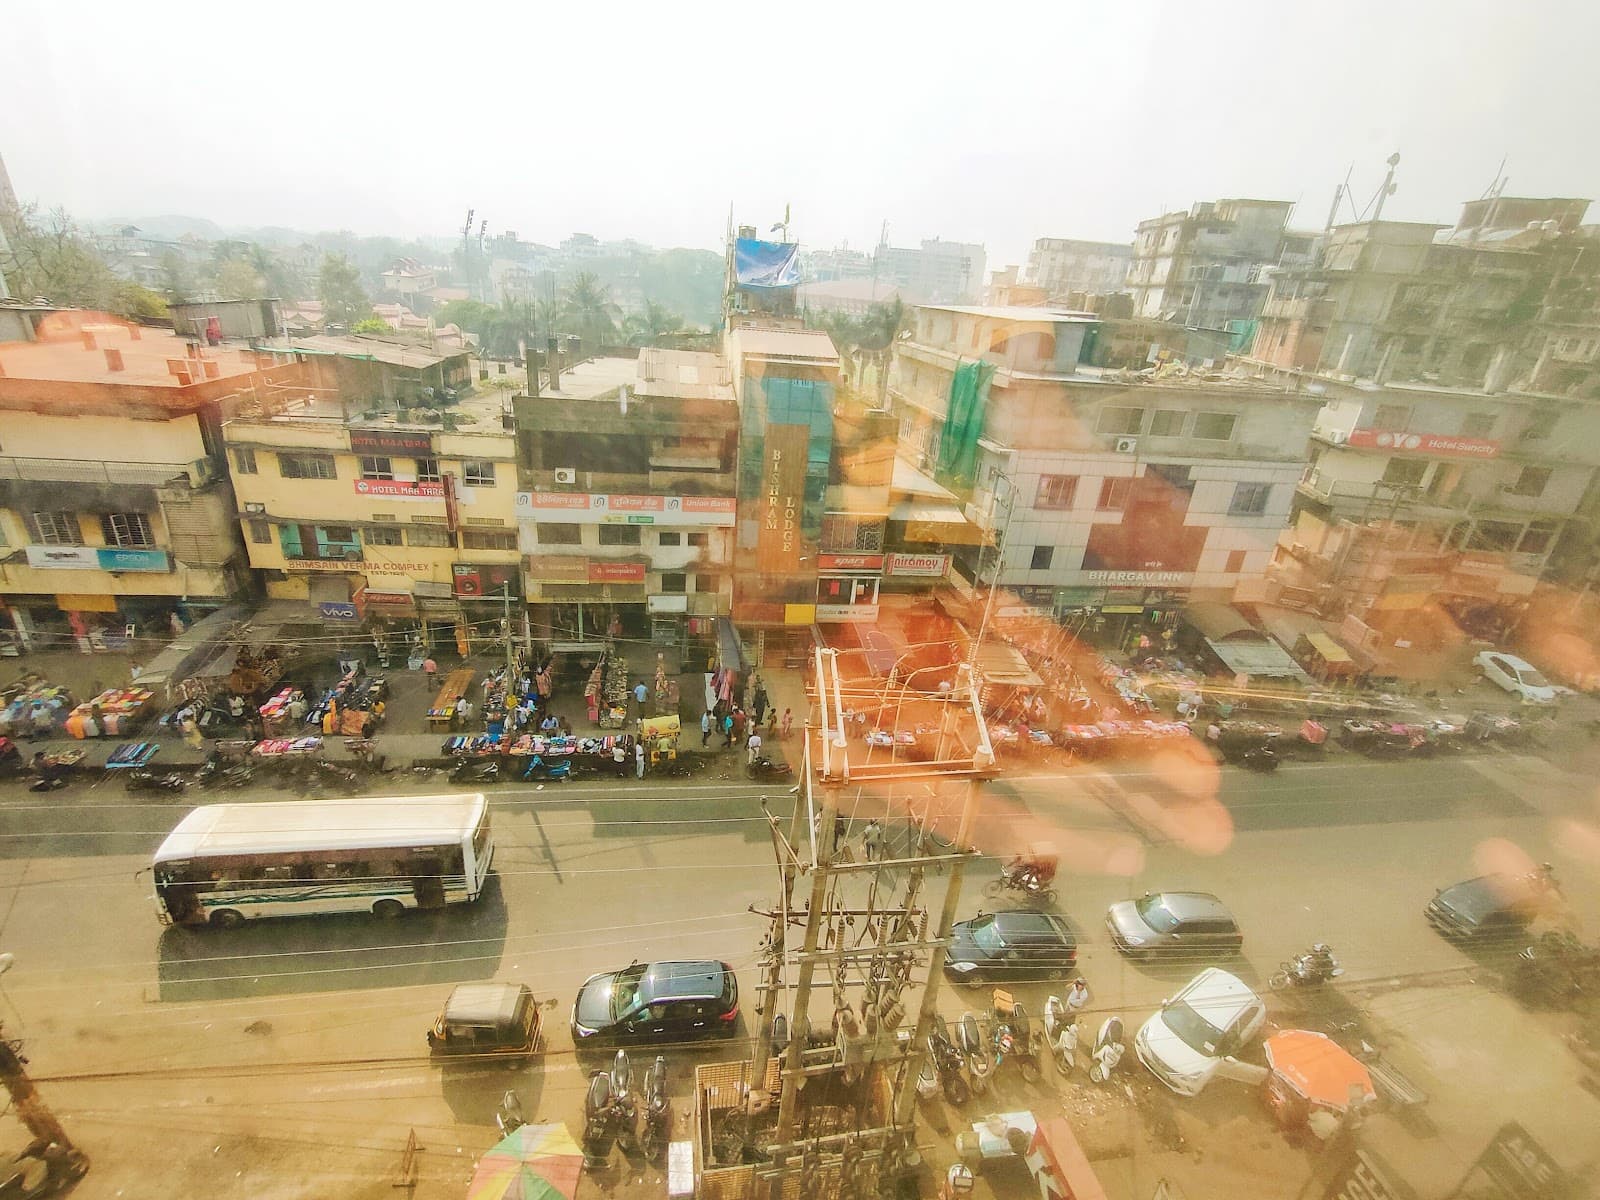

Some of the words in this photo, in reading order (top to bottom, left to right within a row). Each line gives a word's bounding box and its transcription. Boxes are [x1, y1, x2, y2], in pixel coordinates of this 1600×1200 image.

[1376, 432, 1421, 449] OYO
[1428, 439, 1456, 448] Hotel
[371, 486, 399, 494] HOTEL
[421, 487, 445, 496] TARA
[766, 448, 781, 529] BISHRAM
[783, 496, 795, 552] LODGE
[341, 560, 381, 571] VERMA
[383, 562, 430, 572] COMPLEX
[893, 555, 939, 570] niramoy
[1088, 571, 1154, 581] BHARGAV
[1158, 572, 1183, 582] INN
[322, 607, 354, 617] vivo
